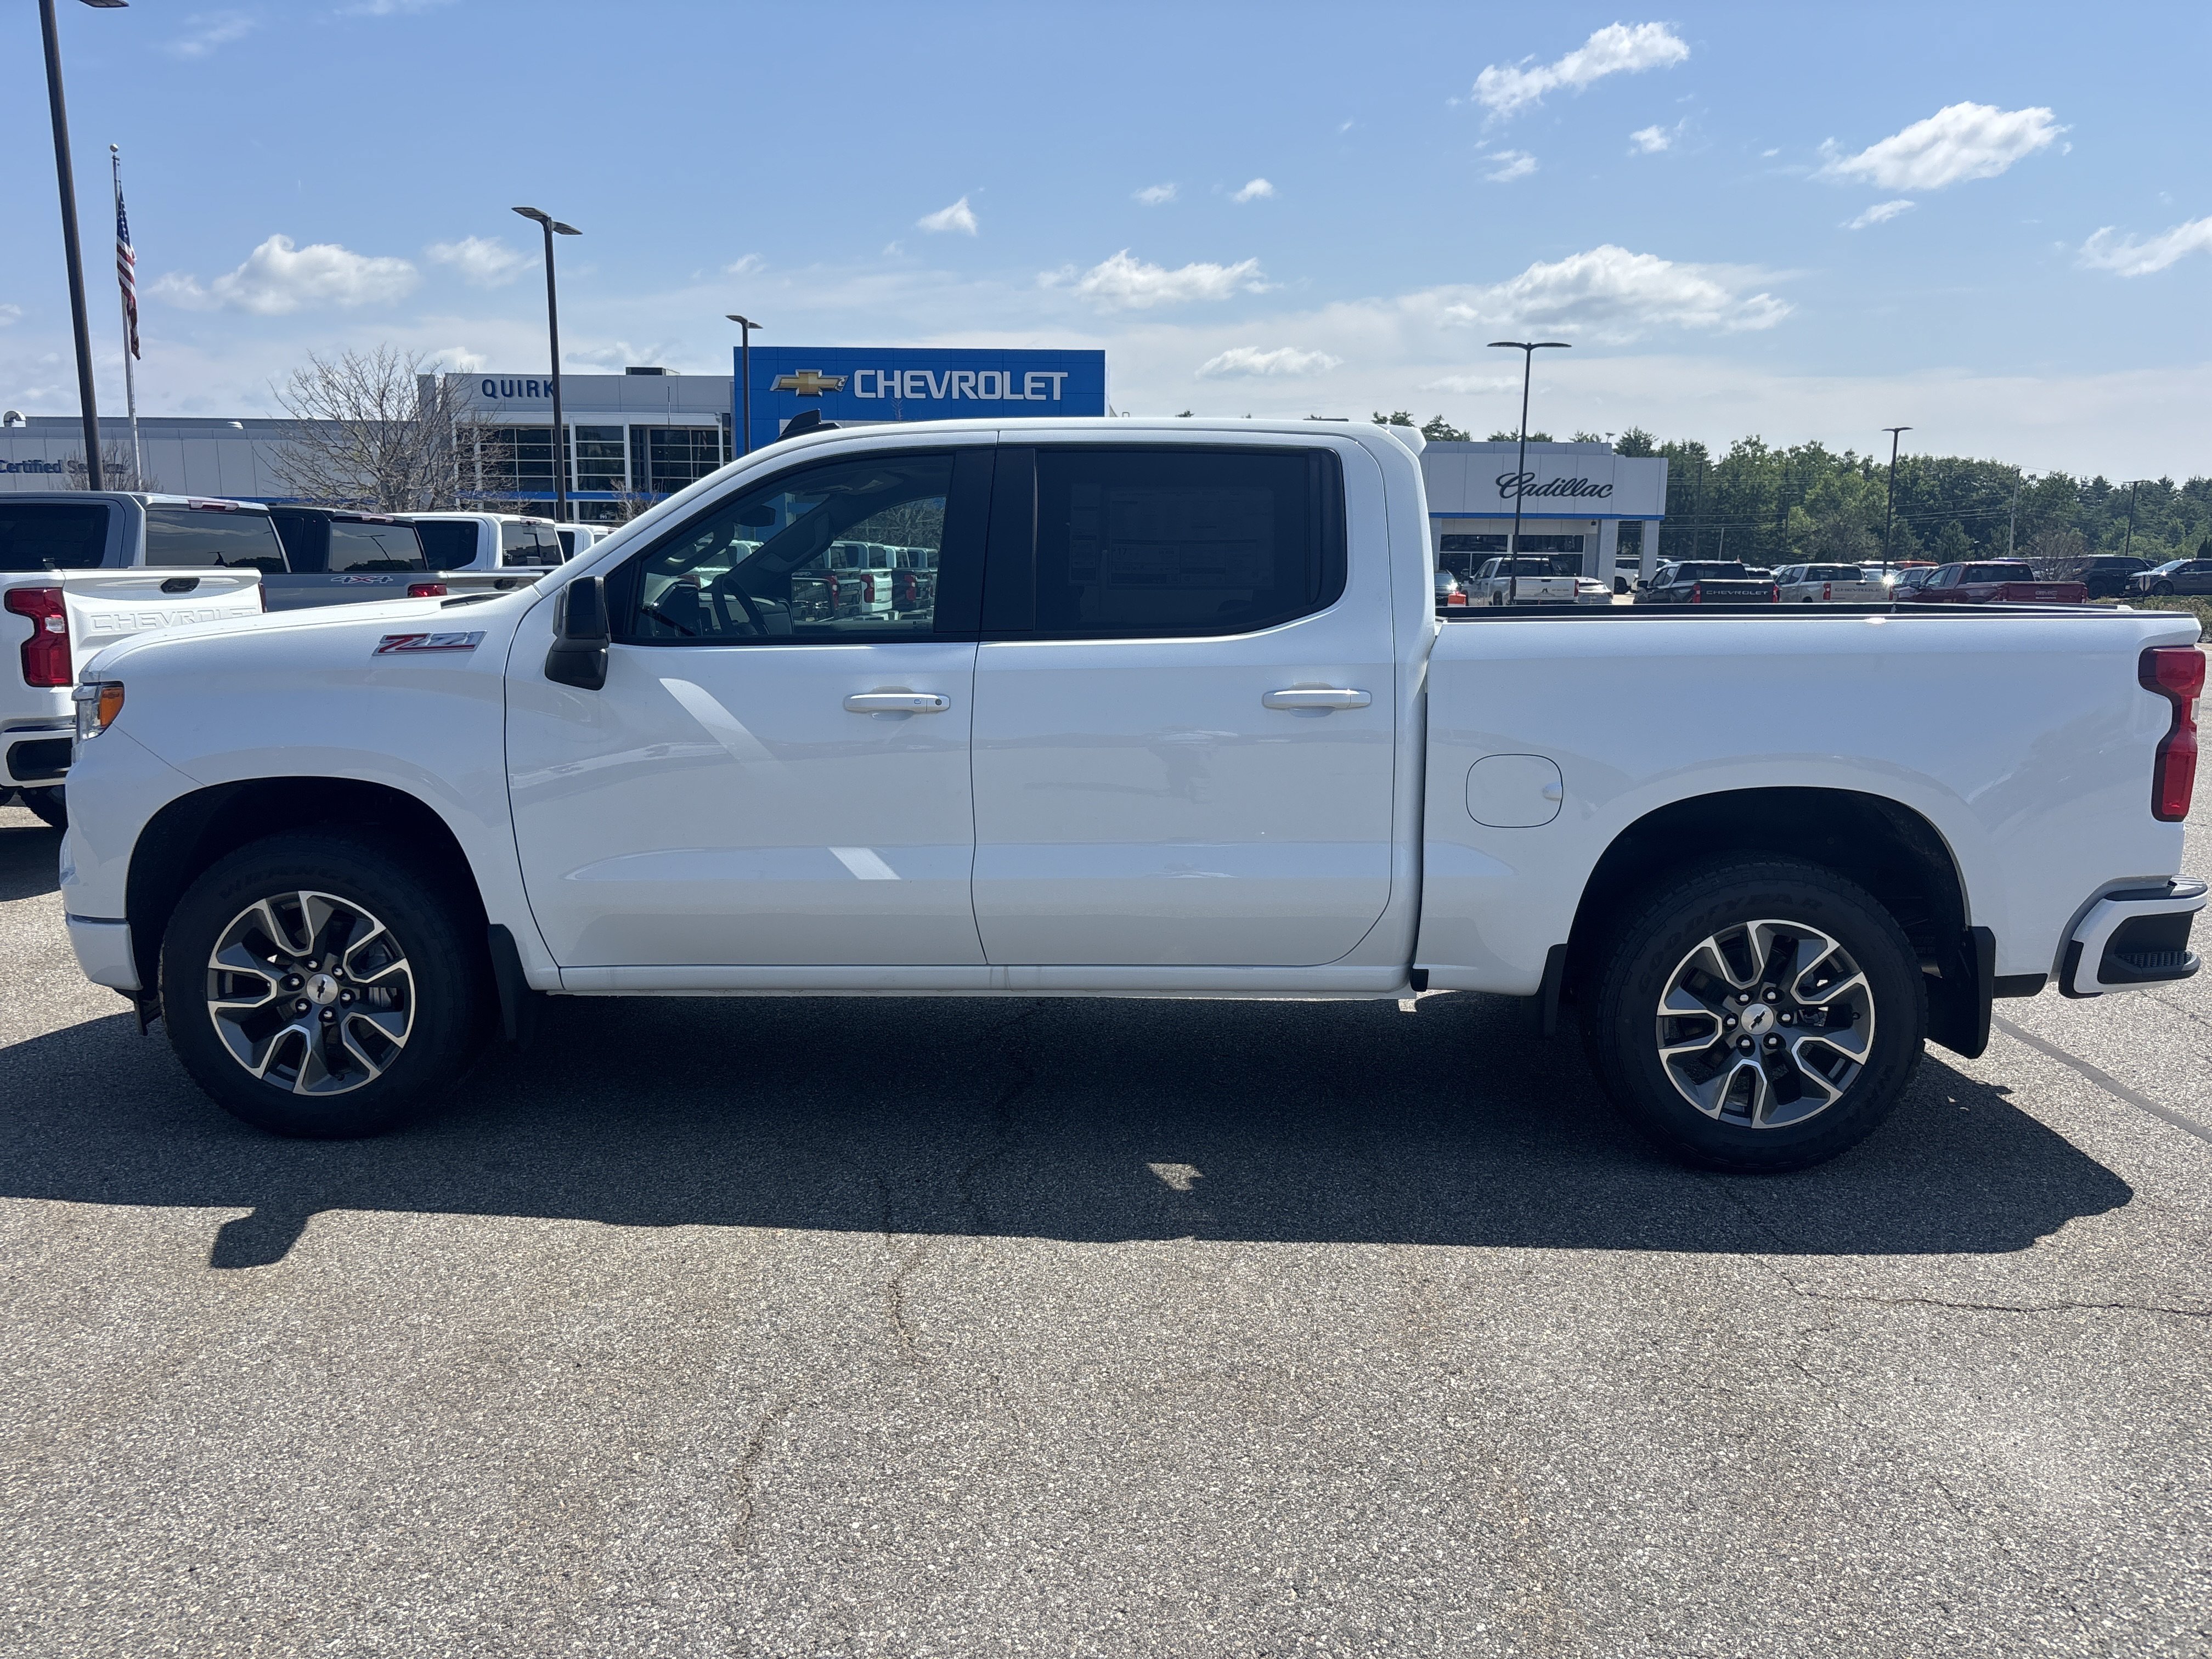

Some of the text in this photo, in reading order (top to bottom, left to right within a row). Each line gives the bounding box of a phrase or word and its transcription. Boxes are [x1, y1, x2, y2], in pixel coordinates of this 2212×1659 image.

[482, 379, 554, 399] QUIRK
[854, 370, 1068, 400] CHEVROLET
[1496, 472, 1613, 499] Cadillac
[373, 630, 488, 656] Z71
